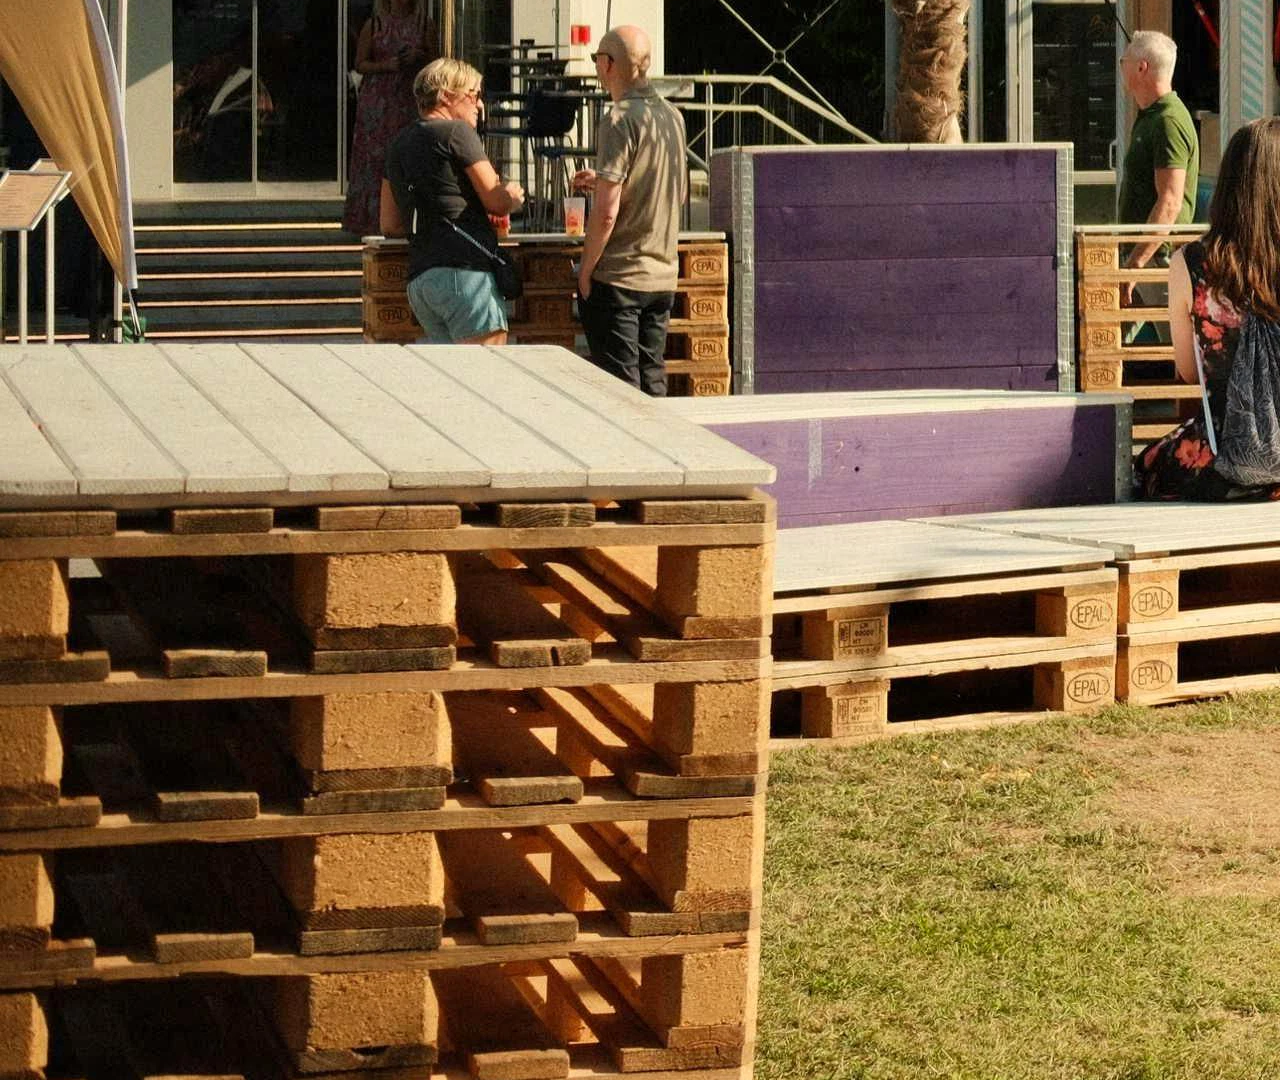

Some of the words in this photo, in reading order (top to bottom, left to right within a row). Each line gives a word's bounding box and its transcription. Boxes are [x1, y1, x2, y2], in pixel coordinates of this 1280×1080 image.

[696, 303, 715, 313] EPAL
[698, 344, 717, 354] EPAL
[699, 383, 719, 393] EPAL
[1138, 591, 1167, 612] EPAL
[1076, 605, 1106, 623] EPAL
[1137, 663, 1165, 686] EPAL
[1073, 680, 1103, 697] EPAL
